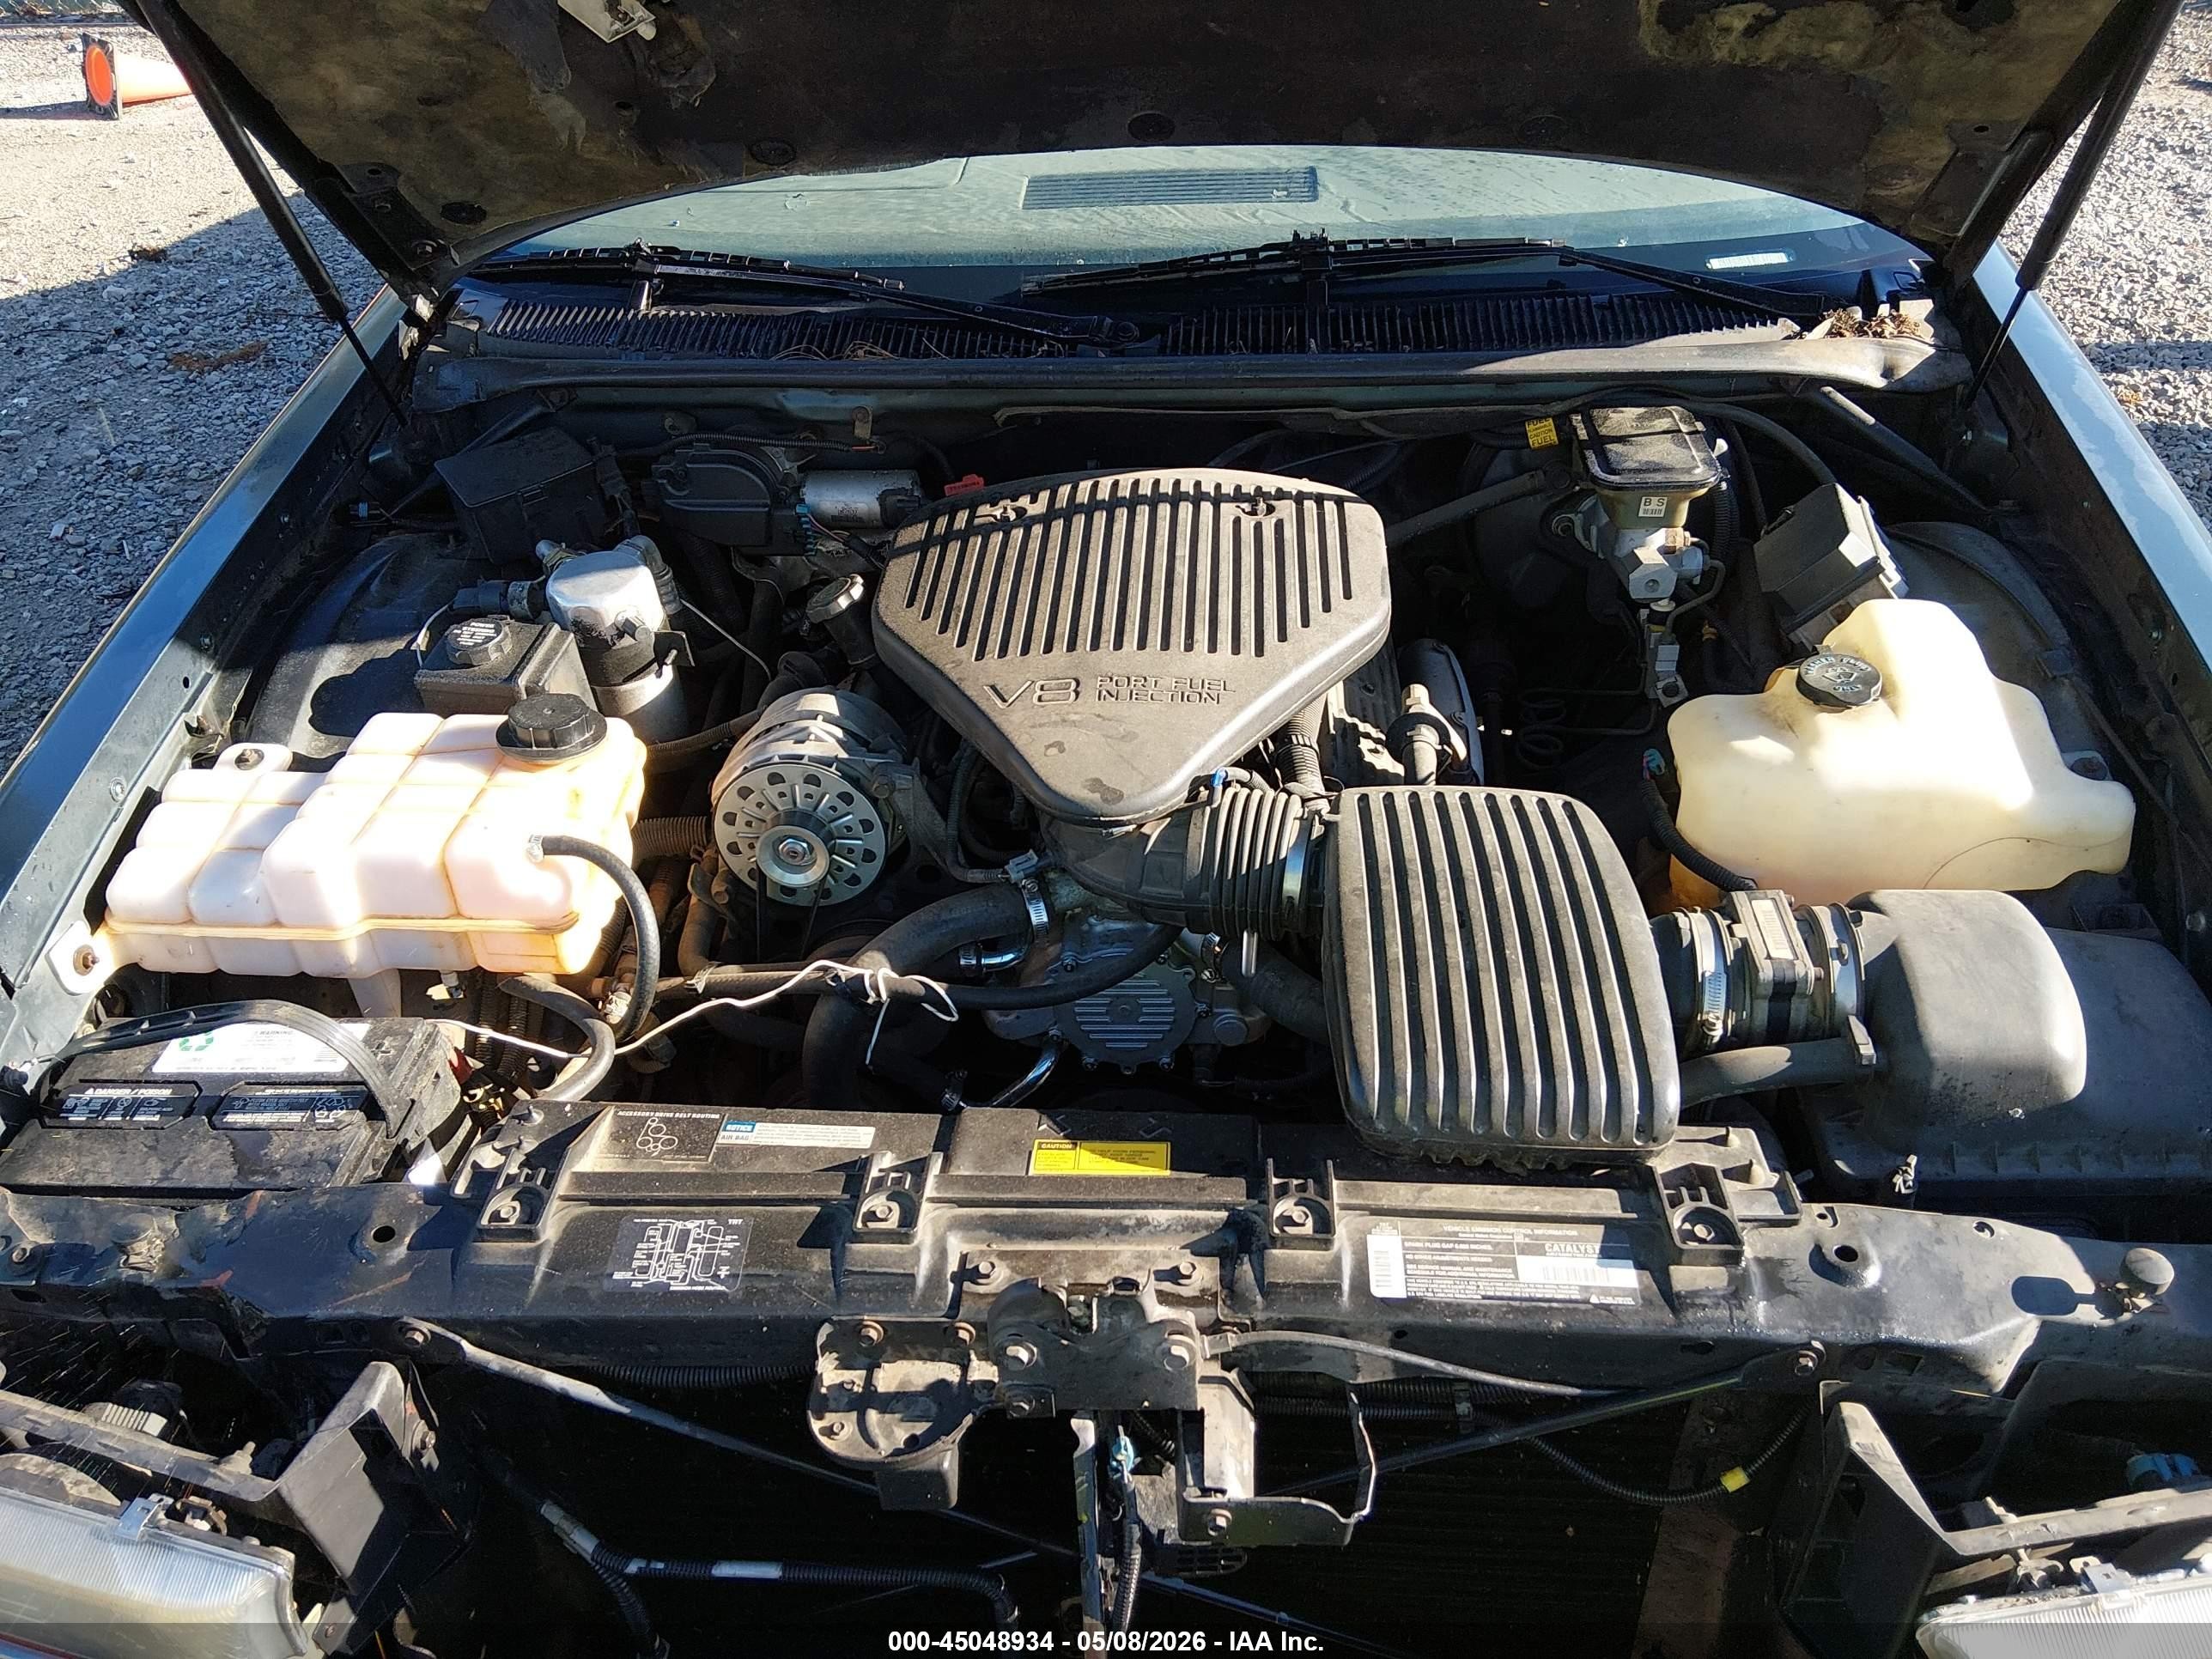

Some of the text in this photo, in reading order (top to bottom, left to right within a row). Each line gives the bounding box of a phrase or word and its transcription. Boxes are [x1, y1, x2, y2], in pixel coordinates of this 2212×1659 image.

[1527, 417, 1552, 428] FUEL
[1529, 428, 1553, 440] CAUTION
[1532, 435, 1555, 446] FUEL
[1096, 675, 1236, 693] PORT FUEL
[983, 678, 1080, 708] V8
[1096, 689, 1221, 704] INJECTION
[1545, 1243, 1601, 1254] CATALYST
